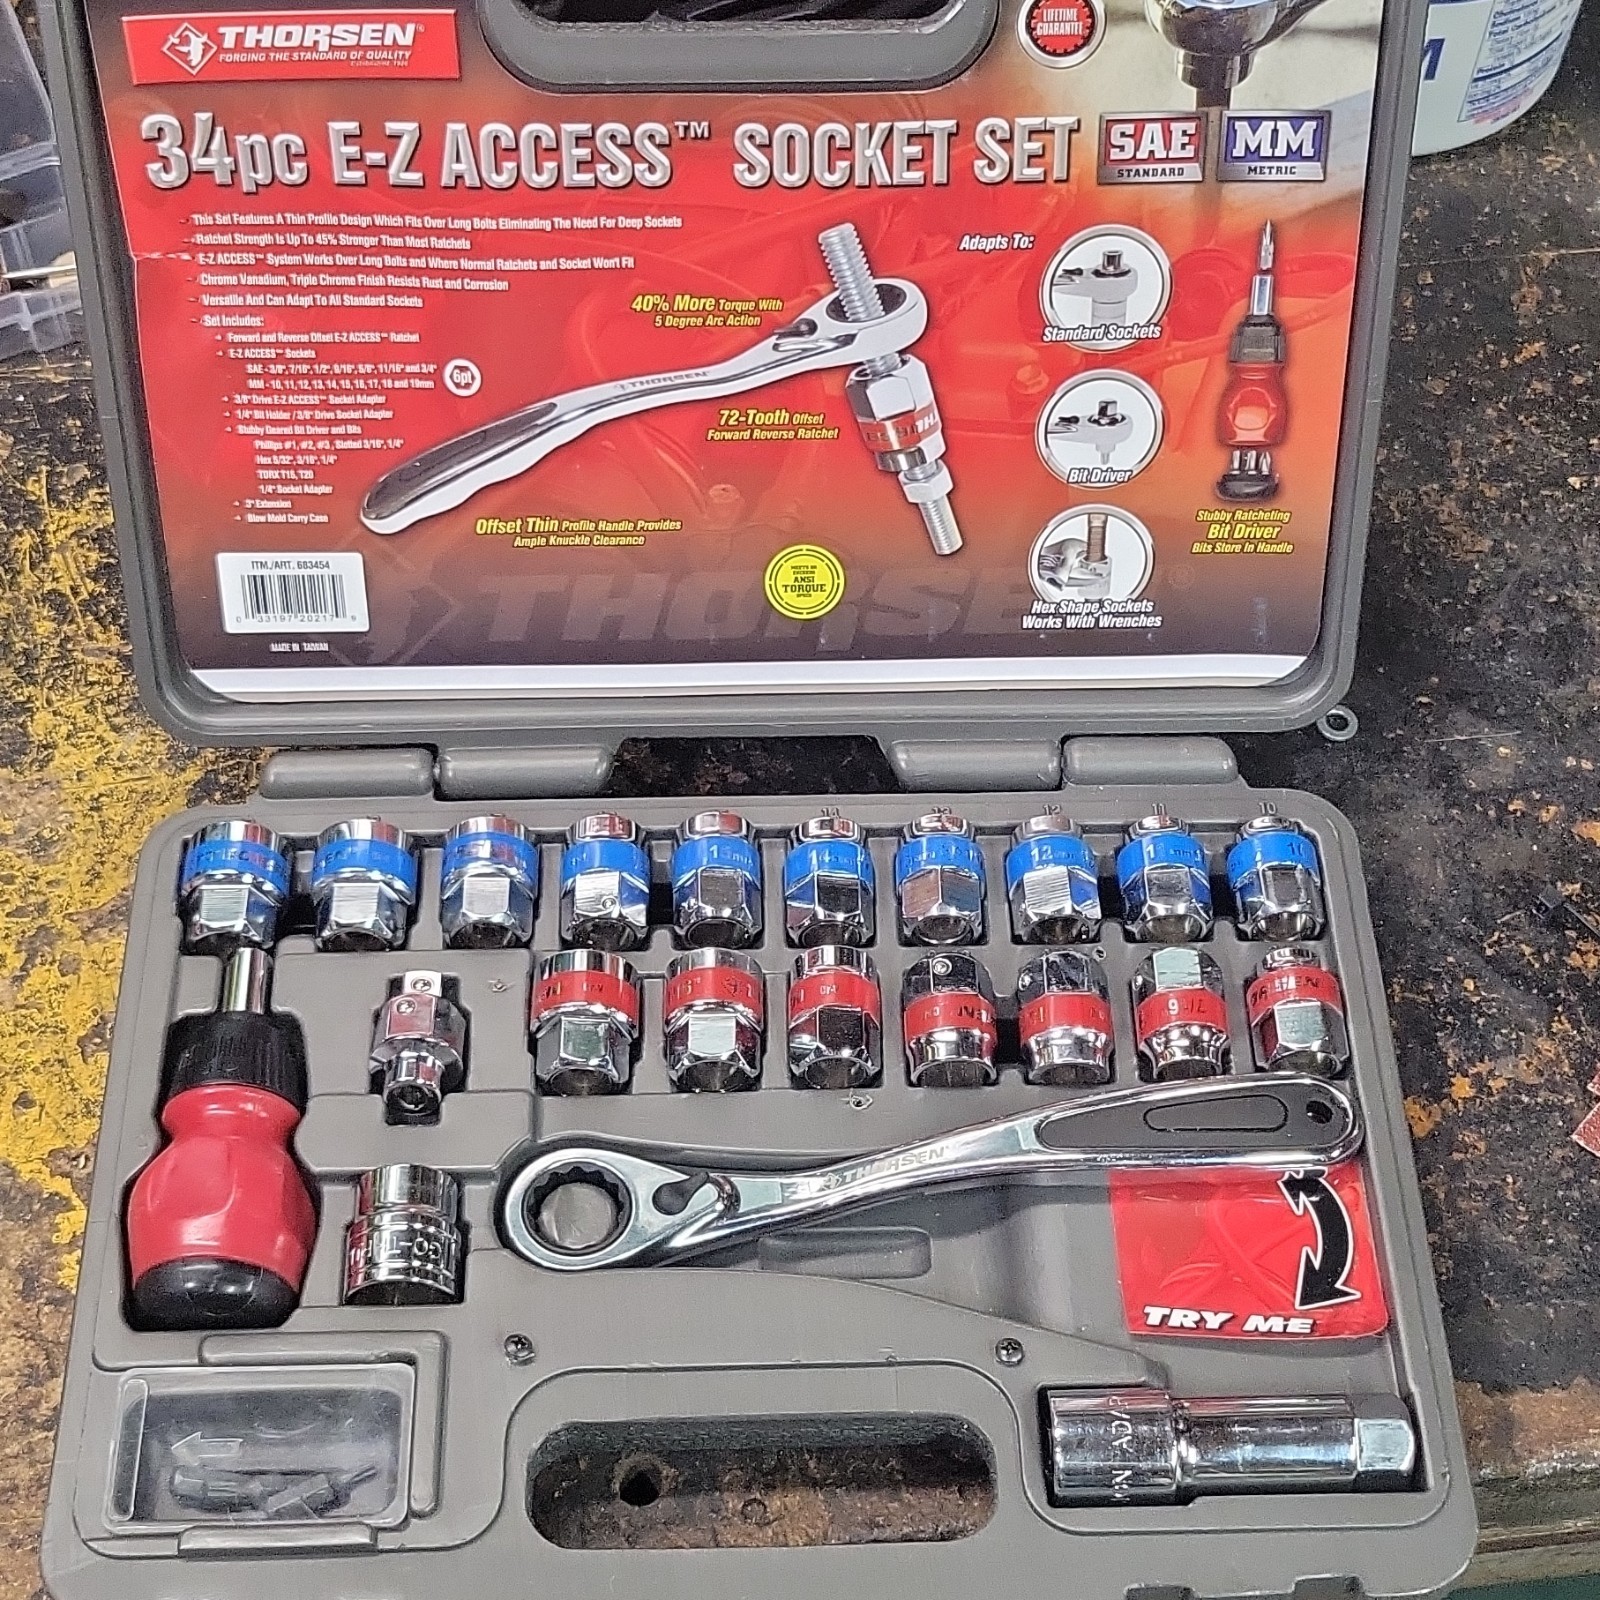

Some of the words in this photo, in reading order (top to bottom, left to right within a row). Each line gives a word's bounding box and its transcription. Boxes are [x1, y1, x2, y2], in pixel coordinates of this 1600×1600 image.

[1043, 8, 1078, 21] LIFETIME
[219, 52, 266, 62] FORGING
[269, 52, 289, 62] THE
[292, 51, 347, 62] STANDARD
[350, 51, 364, 60] OF
[366, 50, 412, 60] QUALITY
[1109, 122, 1198, 161] SAE
[1232, 121, 1317, 158] MM
[141, 112, 308, 193] 34pc
[327, 122, 424, 187] E-Z
[733, 119, 958, 188] SOCKET
[974, 116, 1080, 184] SET
[1117, 167, 1185, 178] STANDARD
[1247, 165, 1297, 176] METRIC
[192, 213, 213, 225] This
[215, 213, 232, 225] Set
[232, 213, 274, 225] Features
[277, 213, 284, 225] A
[284, 213, 306, 225] Thin
[307, 213, 338, 226] Profile
[340, 214, 372, 228] Design
[374, 215, 403, 227] Which
[405, 216, 422, 228] Fits
[424, 217, 445, 228] Over
[448, 217, 471, 231] Long
[473, 218, 497, 230] Bolts
[499, 217, 551, 231] Eliminating
[553, 217, 571, 229] The
[573, 217, 598, 229] Need
[600, 216, 616, 228] For
[618, 216, 643, 230] Deep
[644, 216, 682, 228] Sockets
[195, 233, 232, 245] Ratchet
[234, 233, 274, 247] Strength
[275, 233, 285, 245] Is
[286, 233, 300, 247] Up
[301, 233, 314, 245] To
[316, 234, 338, 245] 45%
[339, 234, 379, 248] Stronger
[380, 235, 404, 247] Than
[405, 236, 429, 248] Most
[430, 237, 471, 250] Ratchets
[959, 235, 1008, 252] Adapts
[1012, 234, 1035, 249] To:
[199, 252, 215, 265] E-Z
[267, 253, 302, 267] System
[303, 253, 333, 265] Works
[336, 254, 357, 266] Over
[359, 255, 383, 268] Long
[384, 255, 407, 267] Bolts
[409, 256, 426, 268] and
[427, 257, 458, 269] Where
[460, 258, 495, 270] Normal
[496, 259, 538, 270] Ratchets
[540, 259, 557, 270] and
[559, 257, 591, 269] Socket
[592, 257, 620, 269] Won't
[621, 256, 635, 268] Fit
[200, 273, 238, 286] Chrome
[239, 273, 289, 287] Vanadium,
[290, 273, 318, 288] Triple
[319, 273, 356, 286] Chrome
[357, 274, 386, 286] Finish
[386, 275, 421, 287] Resists
[421, 277, 443, 289] Rust
[445, 278, 462, 289] and
[463, 278, 509, 291] Corrosion
[201, 293, 244, 306] Versatile
[246, 293, 264, 306] And
[266, 293, 285, 306] Can
[285, 293, 314, 308] Adapt
[314, 294, 327, 306] To
[329, 294, 341, 306] All
[343, 295, 385, 306] Standard
[387, 295, 423, 307] Sockets
[631, 295, 669, 312] 40%
[673, 295, 716, 311] More
[719, 299, 755, 314] Torque
[759, 299, 783, 311] With
[202, 314, 220, 327] Set
[222, 314, 264, 327] Includes:
[655, 316, 662, 327] 5
[665, 316, 703, 329] Degree
[705, 316, 724, 327] Arc
[726, 315, 761, 326] Action
[1043, 326, 1102, 341] Standard
[1106, 324, 1162, 339] Sockets
[453, 368, 473, 386] 6pt
[719, 410, 789, 425] 72-Tooth
[792, 412, 824, 425] Offset
[706, 429, 750, 441] Forward
[752, 428, 795, 440] Reverse
[797, 428, 838, 439] Ratchet
[1067, 469, 1089, 483] Bit
[1091, 469, 1132, 483] Driver
[1196, 510, 1232, 522] Stubby
[1234, 510, 1291, 522] Ratcheting
[476, 518, 522, 534] Offset
[526, 518, 558, 533] Thin
[561, 521, 595, 531] Profile
[598, 520, 634, 531] Handle
[636, 519, 682, 531] Provides
[1207, 524, 1231, 539] Bit
[1232, 524, 1280, 539] Driver
[514, 536, 547, 549] Ample
[549, 535, 590, 546] Knuckle
[593, 535, 645, 546] Clearance
[1191, 543, 1213, 554] Bits
[1214, 543, 1241, 553] Store
[1244, 543, 1255, 553] In
[1256, 543, 1293, 554] Handle
[297, 560, 330, 570] 683454
[782, 584, 827, 594] TORQUE
[1031, 600, 1058, 614] Hex
[1059, 600, 1100, 617] Shape
[1102, 599, 1154, 613] Sockets
[257, 615, 292, 623] 33197
[300, 614, 335, 622] 20217
[1022, 615, 1062, 629] Works
[1065, 615, 1095, 628] With
[1099, 614, 1163, 628] Wrenches
[1259, 802, 1277, 815] 10
[1144, 1306, 1233, 1330] TRY
[1242, 1314, 1314, 1334] ME
